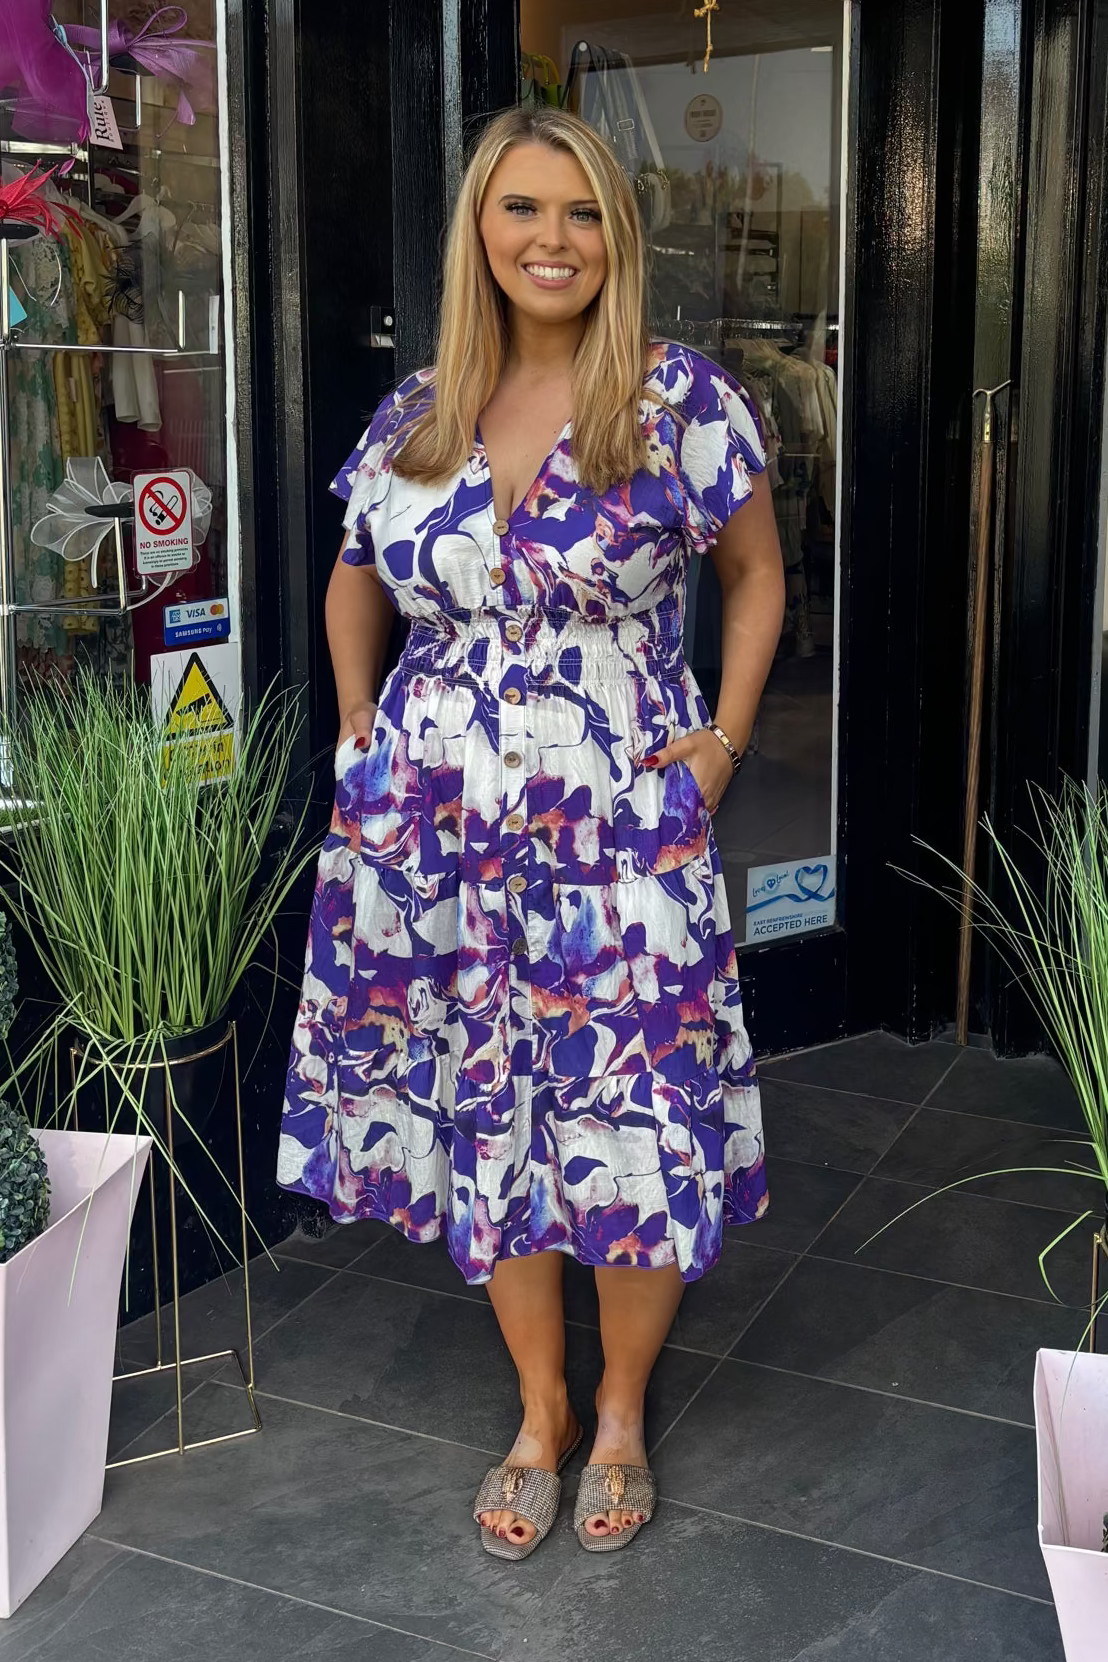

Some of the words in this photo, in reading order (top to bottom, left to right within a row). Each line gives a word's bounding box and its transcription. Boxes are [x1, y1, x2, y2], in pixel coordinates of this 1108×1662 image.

[94, 101, 110, 140] Rule
[140, 541, 151, 549] NO
[153, 537, 189, 548] SMOKING
[186, 608, 206, 618] VISA
[175, 628, 202, 638] SAMSUNG
[753, 920, 802, 936] ACCEPTED
[804, 914, 828, 927] HERE
